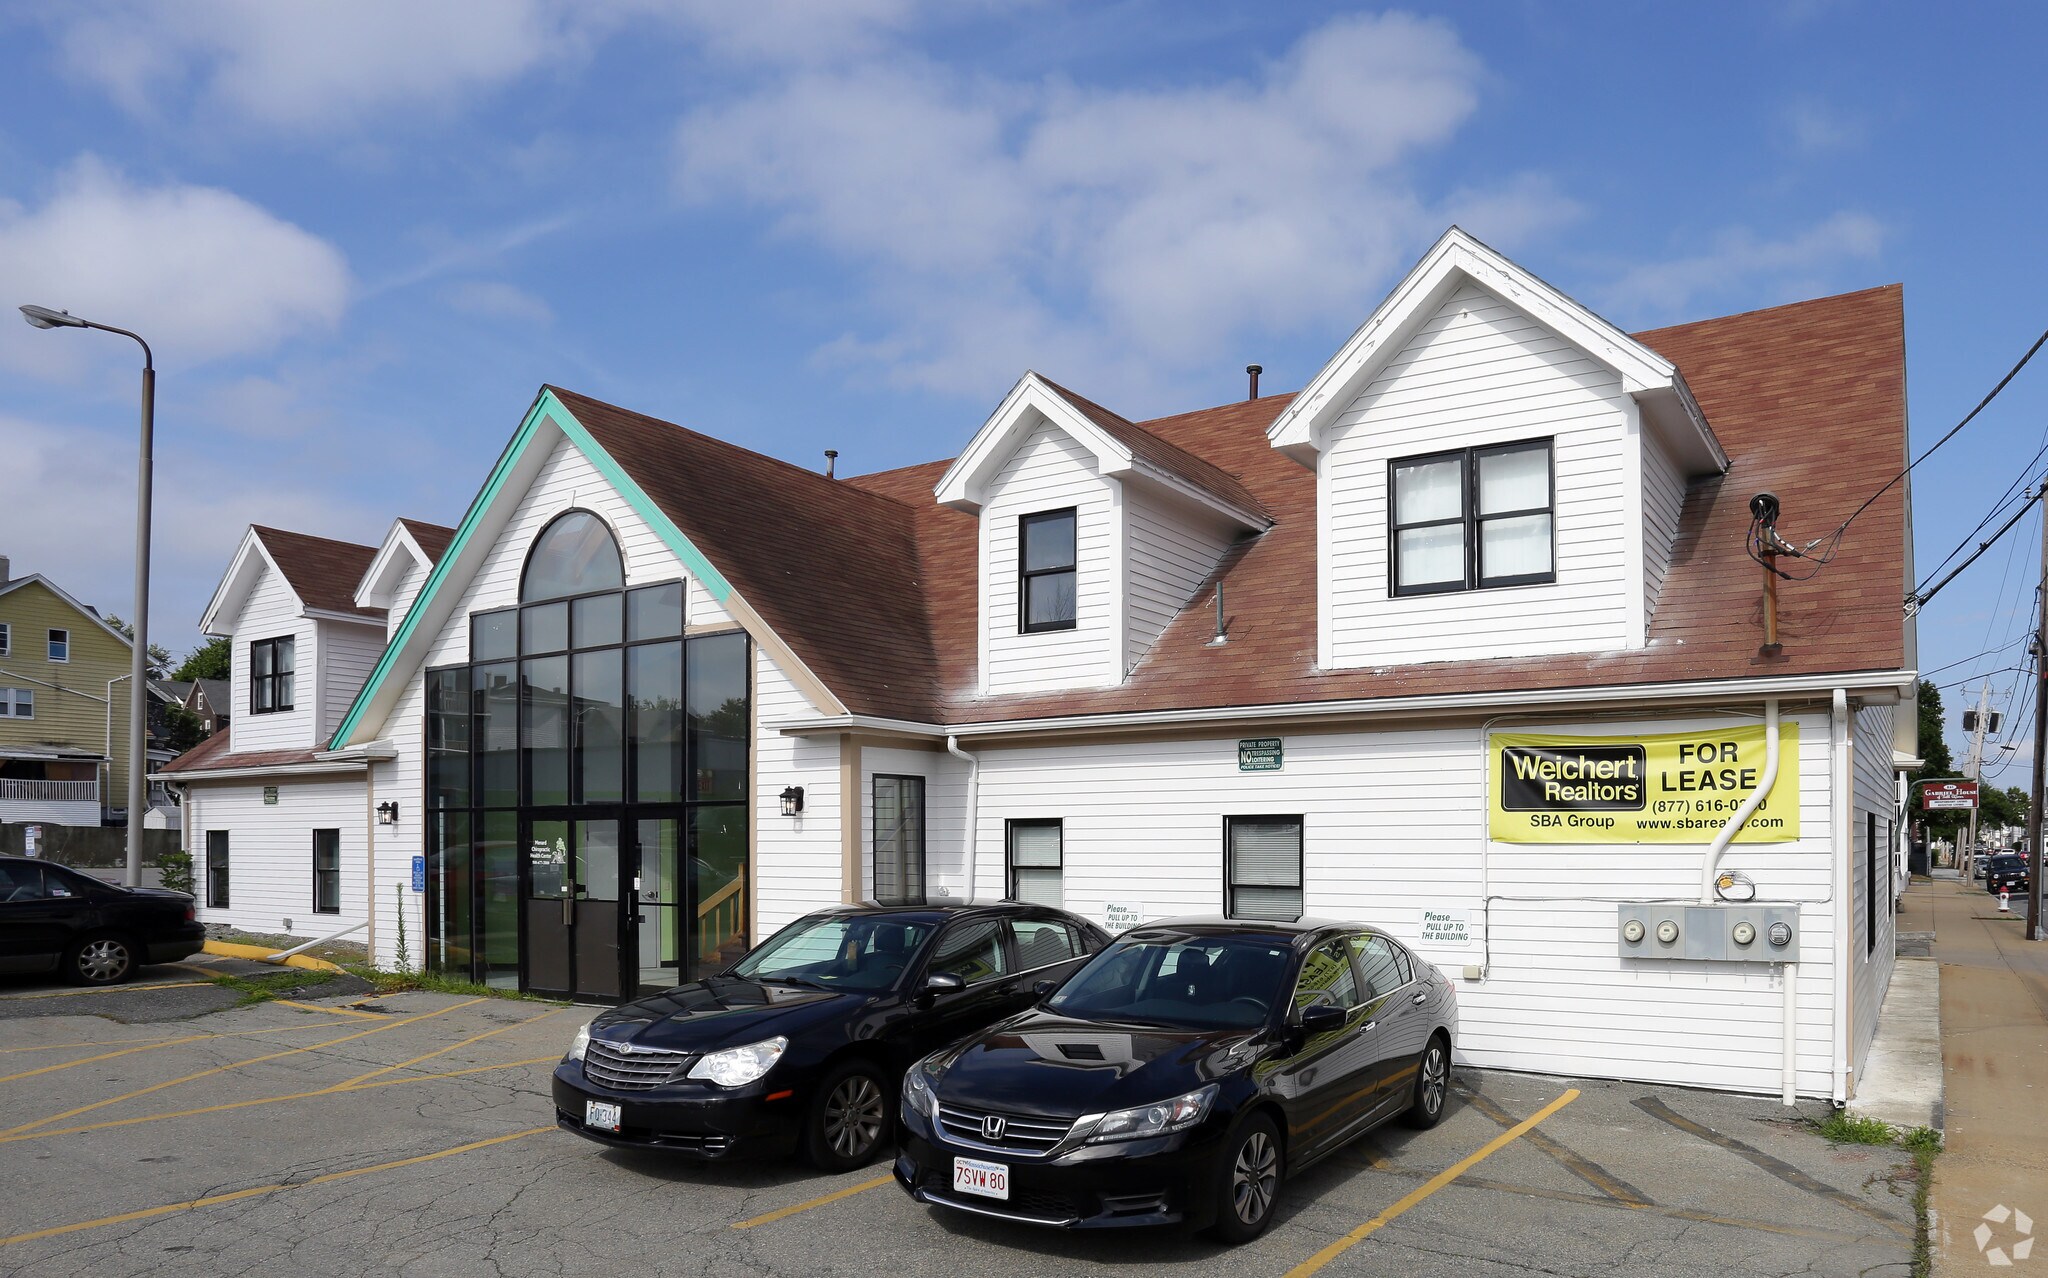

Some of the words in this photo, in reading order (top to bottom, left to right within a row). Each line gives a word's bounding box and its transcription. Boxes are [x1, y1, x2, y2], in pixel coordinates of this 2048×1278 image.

[1258, 740, 1280, 748] PROPERTY
[1241, 751, 1252, 763] NO
[1679, 742, 1738, 764] FOR
[1661, 769, 1757, 791] LEASE
[1652, 800, 1690, 815] (877)
[1695, 799, 1767, 812] 616-00
[1530, 814, 1563, 827] SBA
[1567, 814, 1615, 830] Group
[1106, 904, 1128, 913] Please
[1131, 914, 1138, 922] TO
[1424, 911, 1451, 921] Please
[1426, 922, 1442, 931] PULL
[1443, 923, 1454, 931] UP
[1455, 923, 1465, 931] TO
[1421, 931, 1434, 940] THE
[1435, 932, 1469, 941] BUILDING
[956, 1166, 986, 1188] 7SVW
[990, 1172, 1005, 1190] 80
